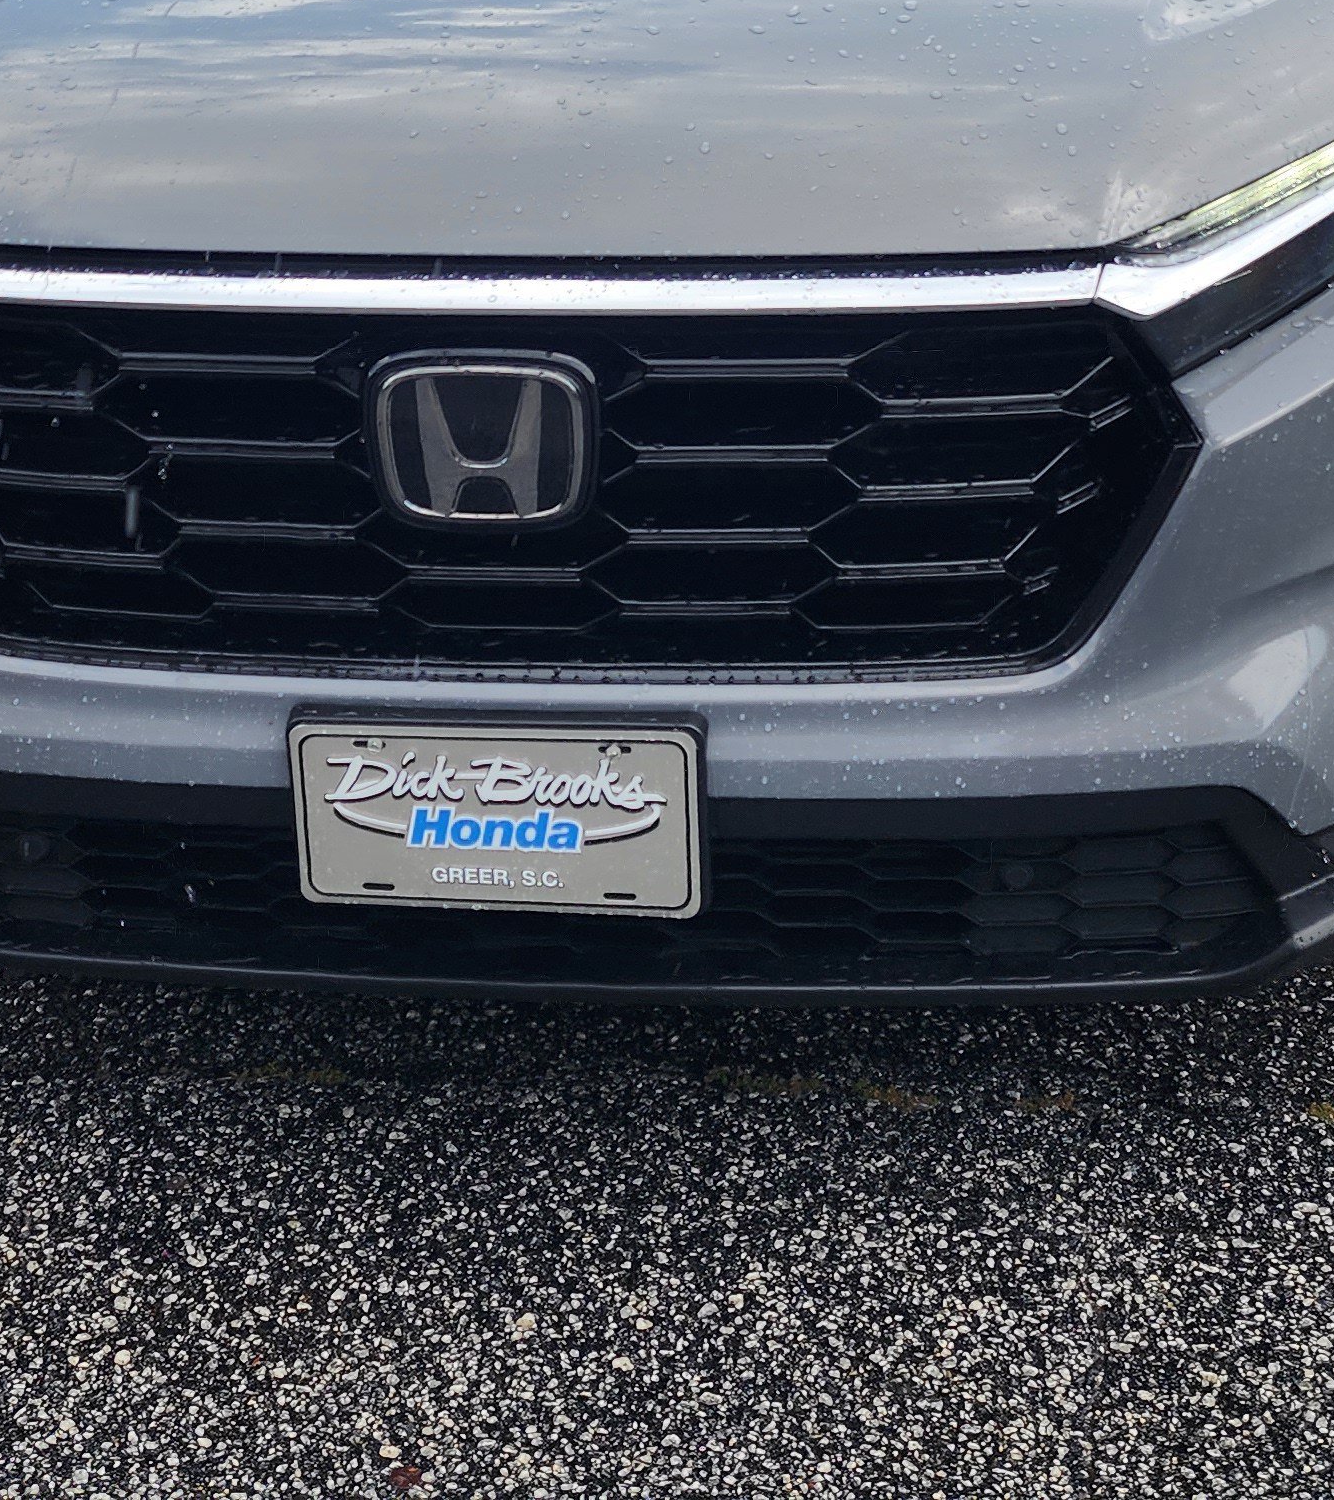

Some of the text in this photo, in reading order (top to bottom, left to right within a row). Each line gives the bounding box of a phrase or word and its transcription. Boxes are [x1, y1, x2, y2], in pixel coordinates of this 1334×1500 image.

[324, 751, 667, 809] Dick Brooks
[407, 807, 584, 852] Honda
[431, 866, 565, 889] GREER, S.C.
